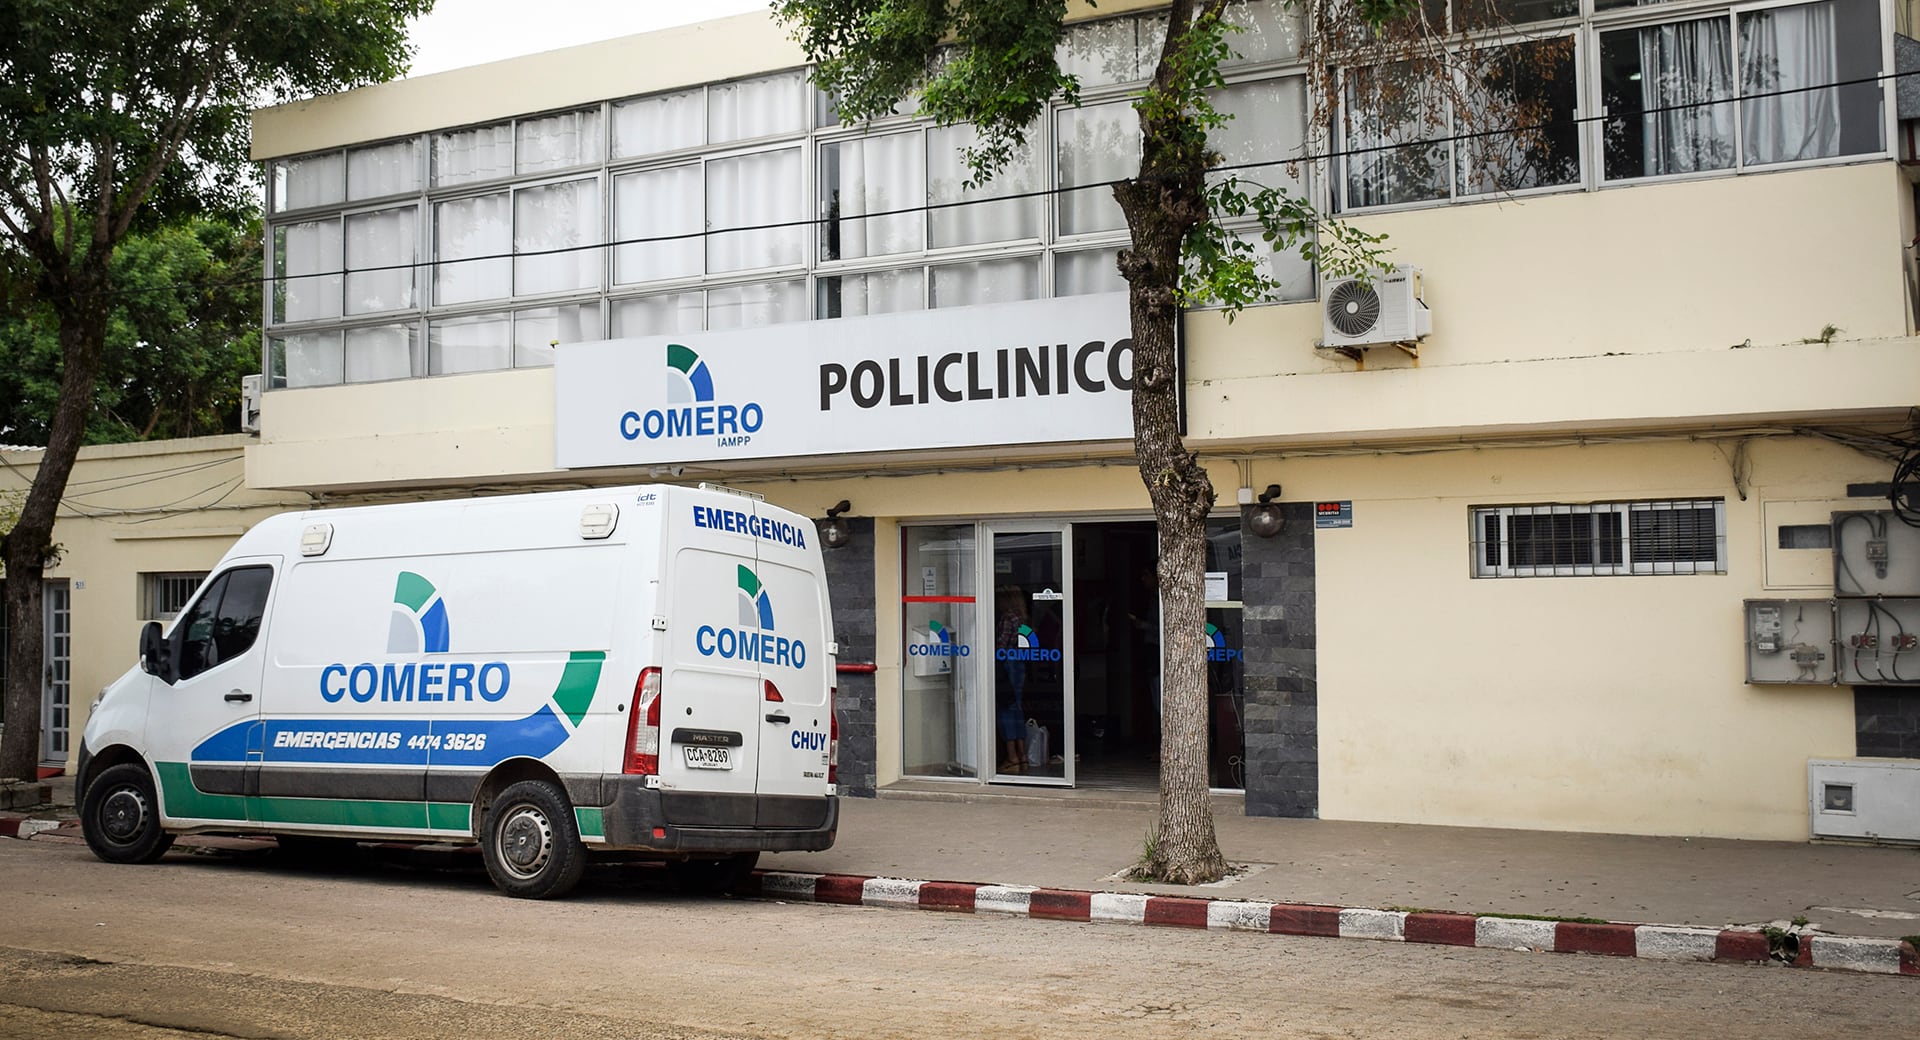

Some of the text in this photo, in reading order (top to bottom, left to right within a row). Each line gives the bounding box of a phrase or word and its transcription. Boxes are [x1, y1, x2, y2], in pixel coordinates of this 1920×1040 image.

[820, 338, 1133, 411] POLICLINICO
[620, 403, 763, 440] COMERO
[717, 436, 751, 447] IAMPP
[693, 506, 806, 550] EMERGENCIA
[696, 625, 806, 669] COMERO
[909, 644, 970, 657] COMERO
[996, 648, 1061, 662] COMERO
[320, 662, 511, 703] COMERO
[274, 731, 487, 751] EMERGENCIAS 4474 3626
[791, 730, 827, 751] CHUY
